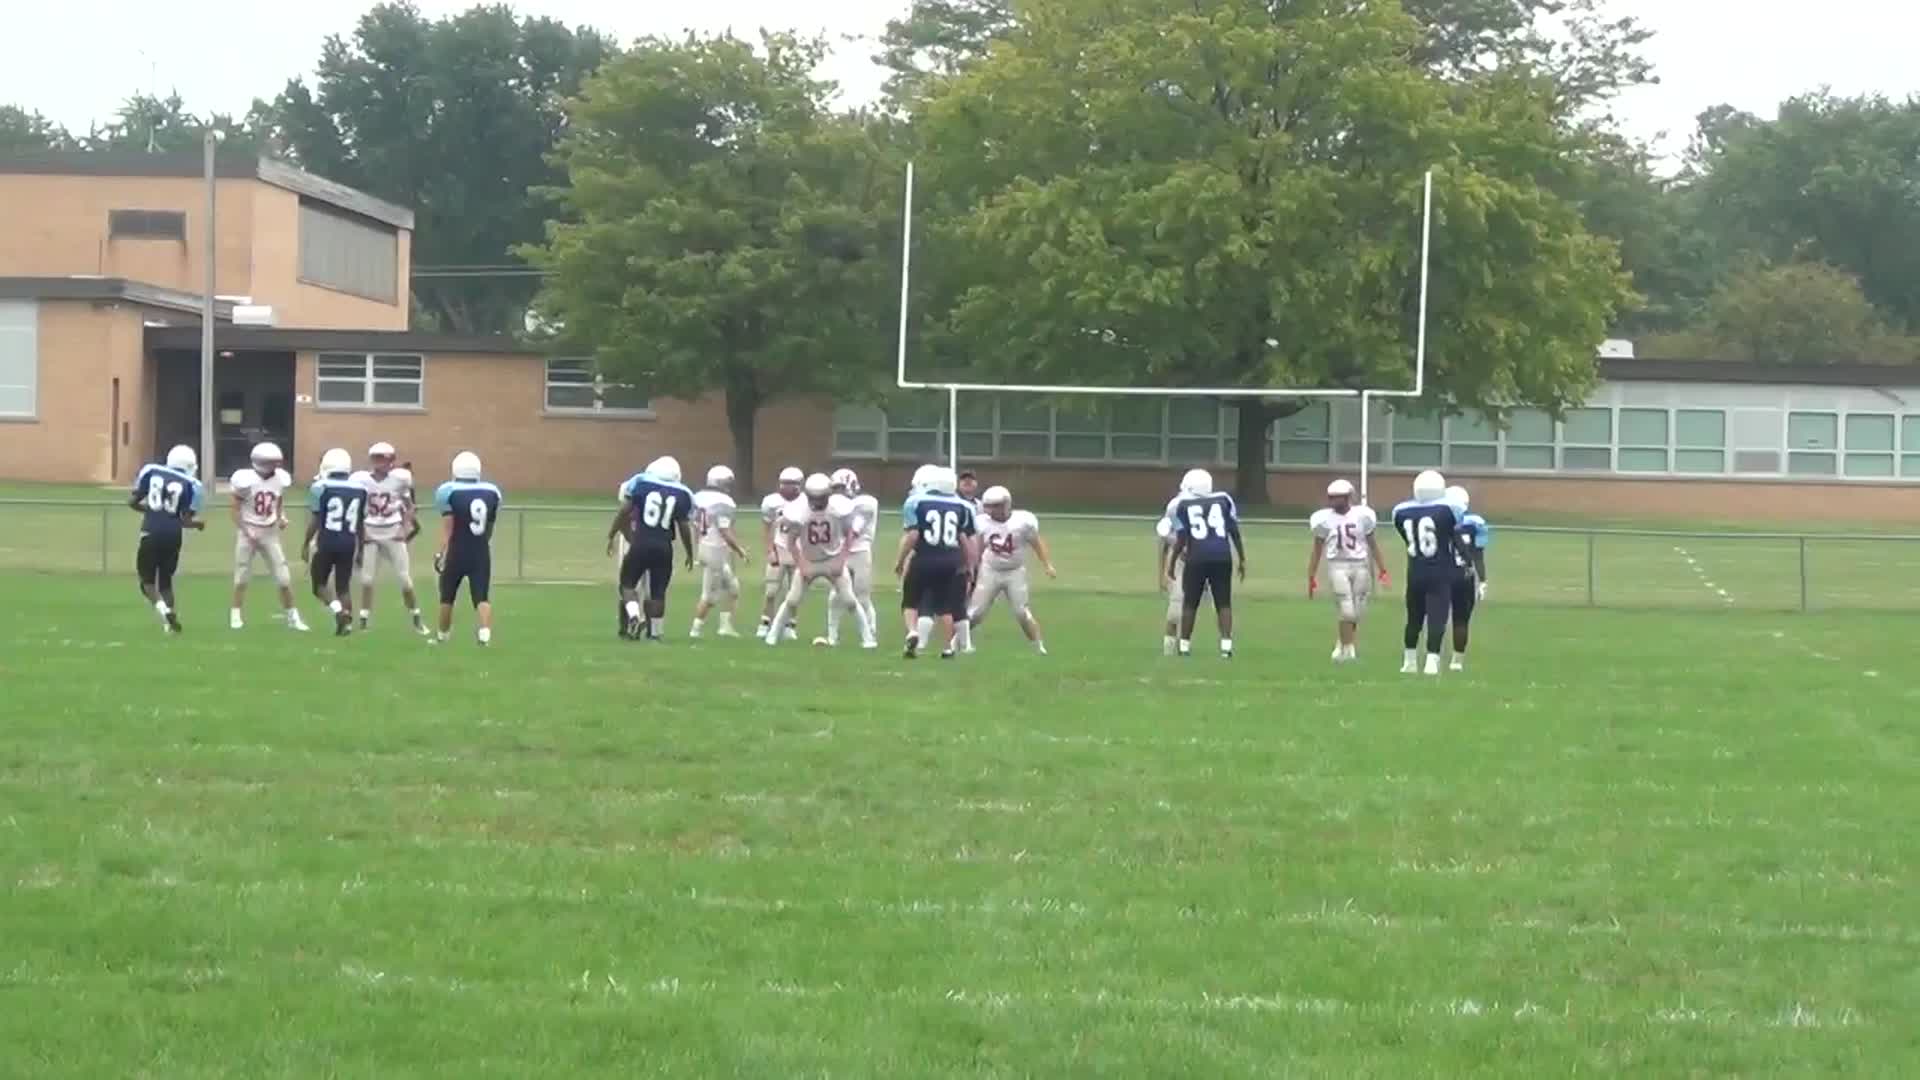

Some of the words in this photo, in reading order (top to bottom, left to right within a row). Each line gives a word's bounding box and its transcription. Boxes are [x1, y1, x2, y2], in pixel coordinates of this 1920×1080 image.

[148, 476, 183, 514] 83
[643, 491, 677, 528] 61
[325, 497, 361, 533] 24
[469, 499, 487, 536] 9
[807, 521, 831, 545] 63
[924, 510, 959, 546] 36
[1187, 503, 1226, 540] 54
[1336, 523, 1356, 550] 15
[1403, 518, 1438, 557] 16
